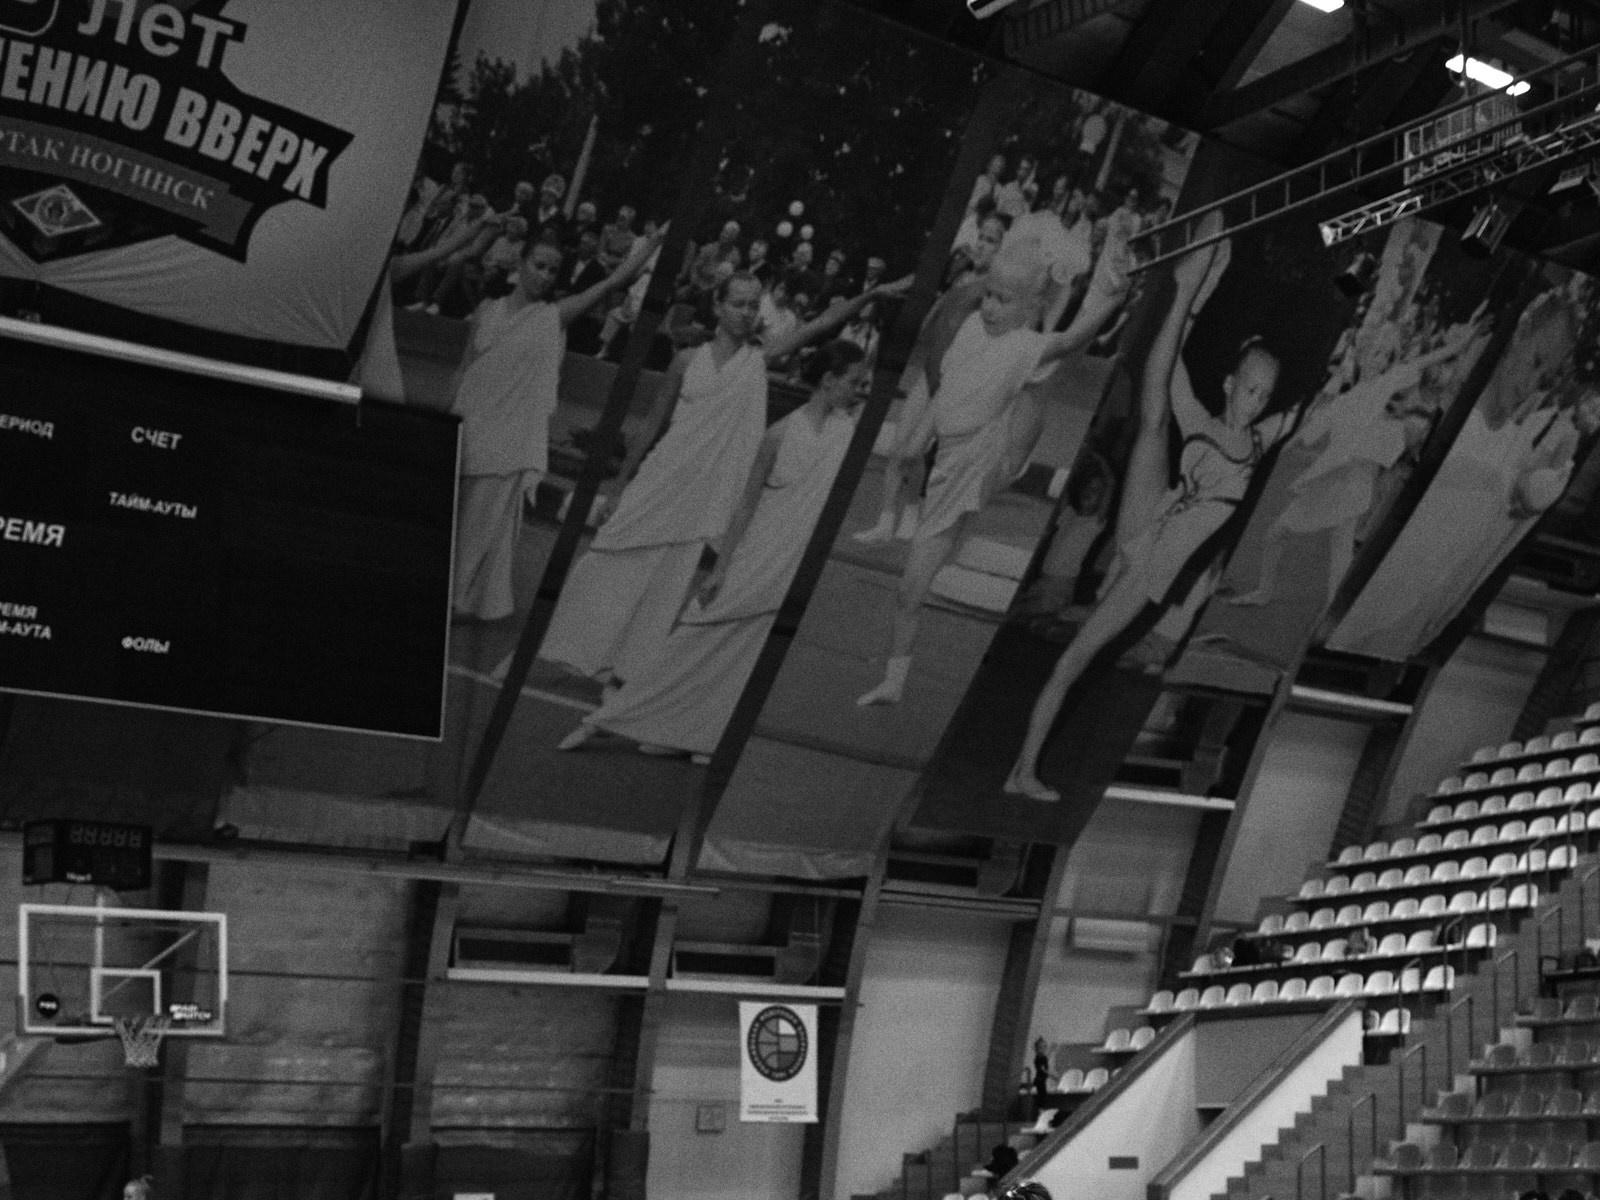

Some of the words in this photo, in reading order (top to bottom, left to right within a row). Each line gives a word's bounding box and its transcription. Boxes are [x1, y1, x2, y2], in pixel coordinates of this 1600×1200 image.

[0, 37, 161, 131] ЕНИЮ
[164, 87, 328, 200] ВВЕРХ
[70, 145, 215, 210] НОГИНСК
[131, 426, 182, 450] СЧЕТ
[109, 491, 198, 519] ТАЙМ-АУТЫ
[0, 602, 38, 619] ЕМЯ
[121, 636, 171, 654] ФОЛЫ
